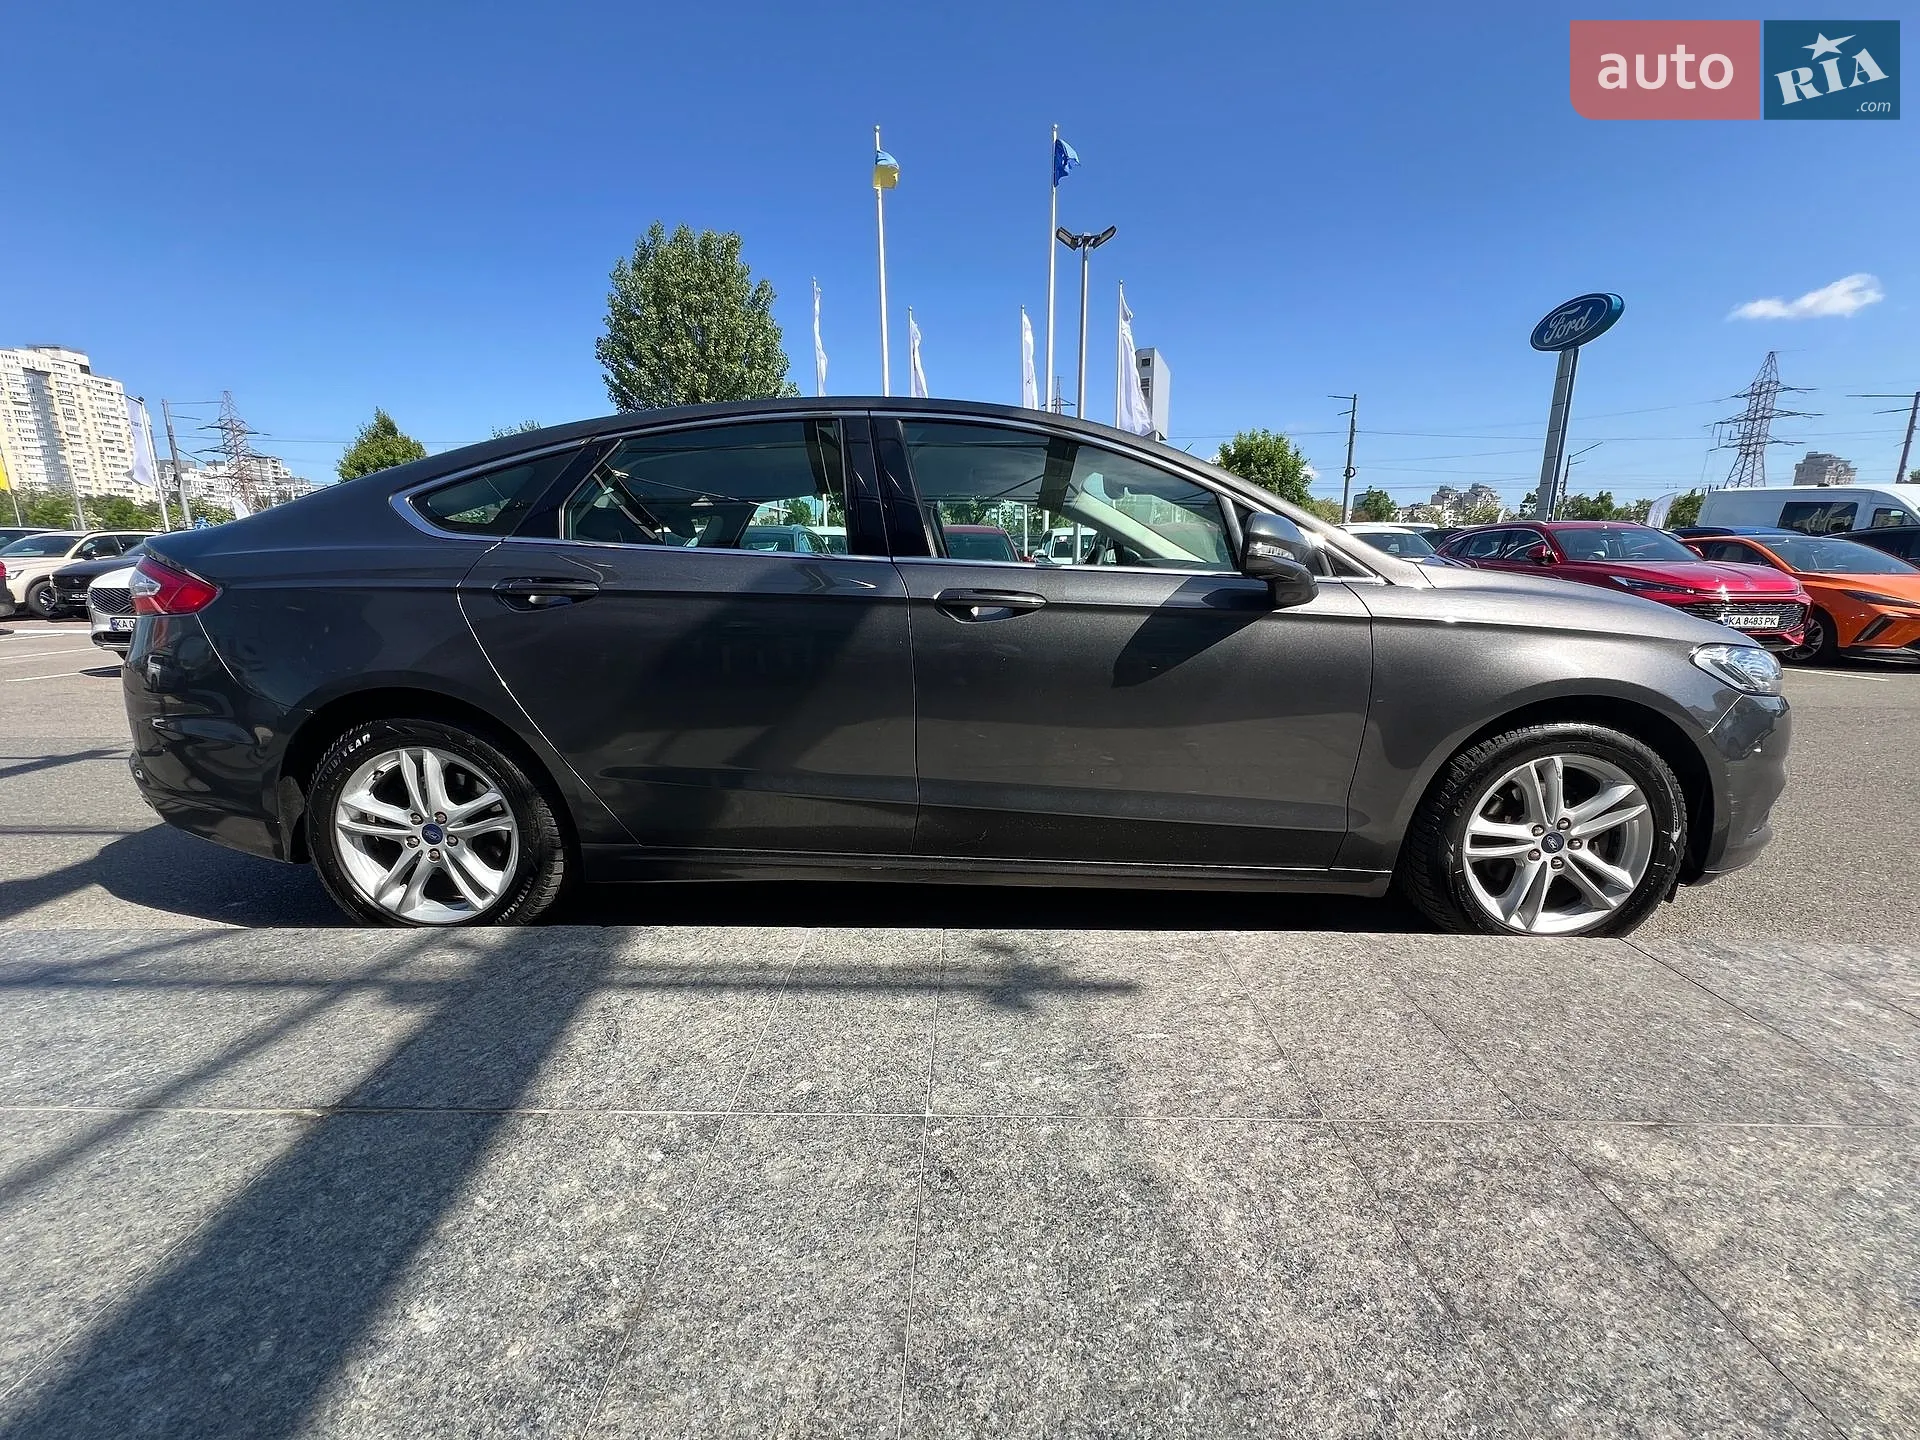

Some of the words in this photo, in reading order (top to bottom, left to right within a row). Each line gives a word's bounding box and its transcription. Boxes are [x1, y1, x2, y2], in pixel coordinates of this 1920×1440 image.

[1543, 305, 1593, 344] Ford
[116, 619, 128, 629] KA
[1728, 616, 1741, 626] KA
[1764, 616, 1777, 626] PK
